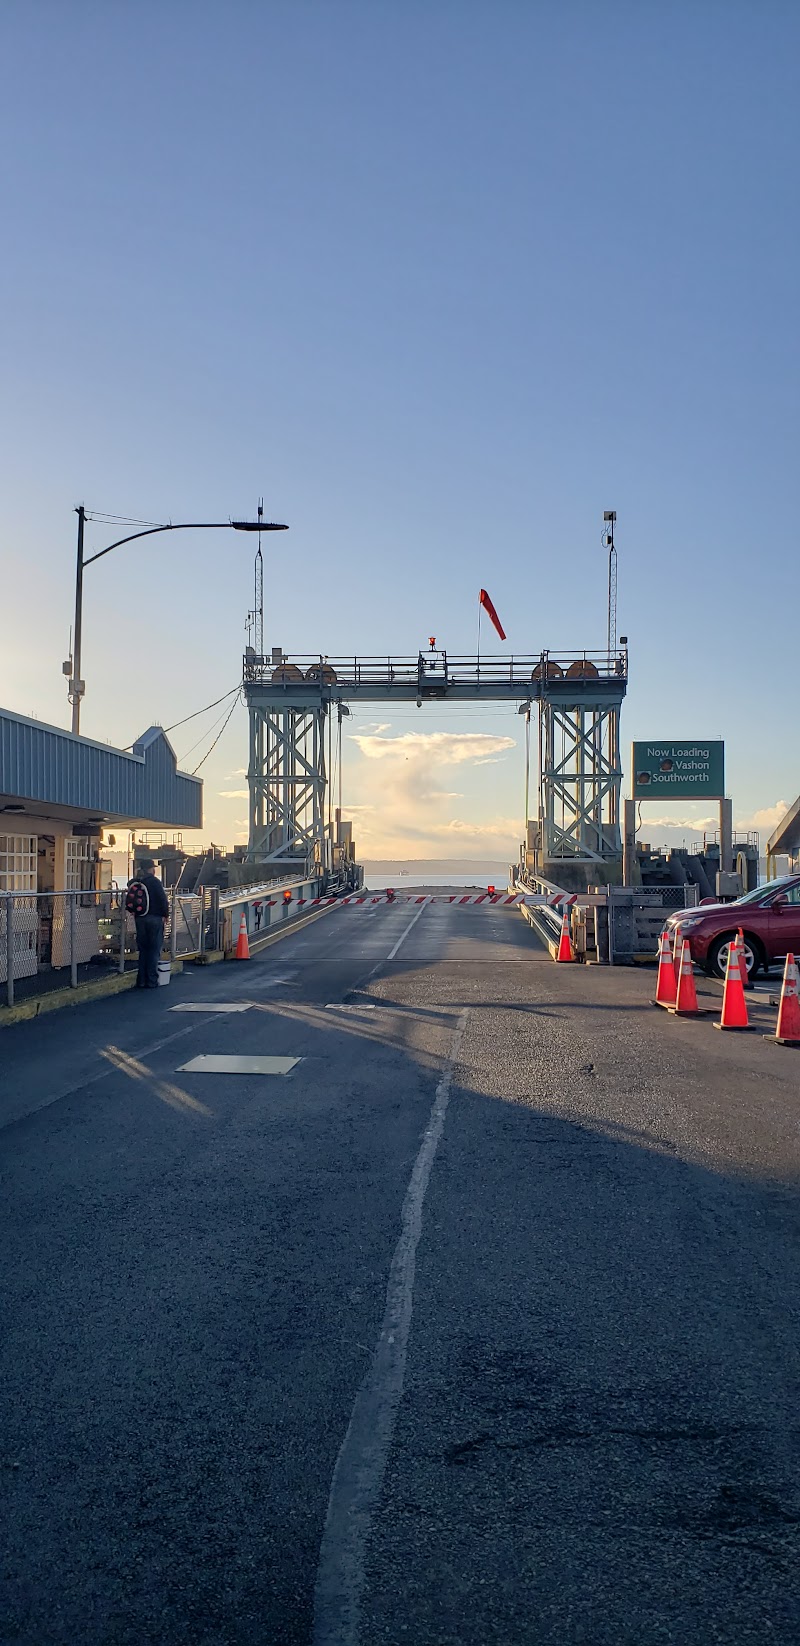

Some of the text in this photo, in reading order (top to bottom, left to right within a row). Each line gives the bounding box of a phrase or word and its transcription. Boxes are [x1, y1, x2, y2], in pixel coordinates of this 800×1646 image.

[647, 748, 710, 759] Now Loading
[675, 761, 710, 770] Vashon
[652, 773, 709, 782] Southworth
